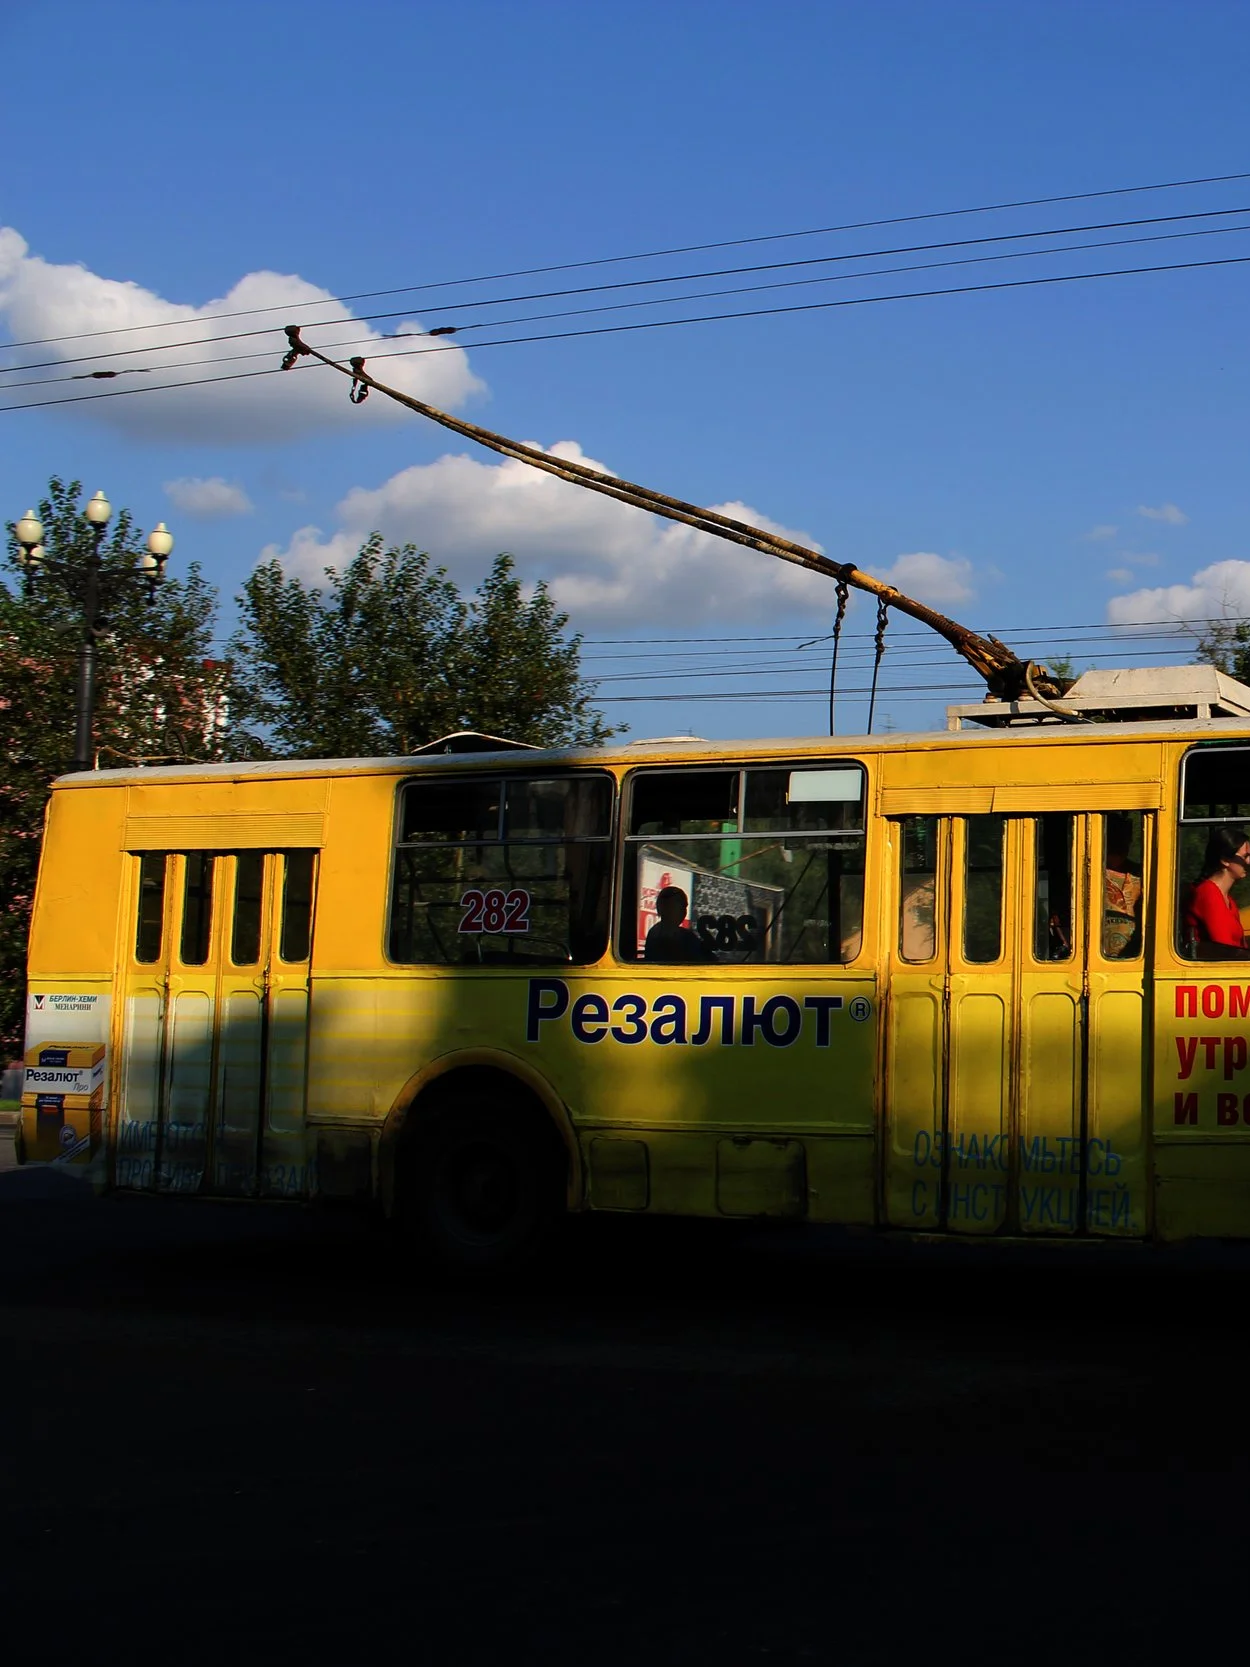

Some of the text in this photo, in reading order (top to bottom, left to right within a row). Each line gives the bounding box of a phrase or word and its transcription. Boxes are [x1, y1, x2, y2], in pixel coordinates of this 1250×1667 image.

[458, 889, 529, 933] 282
[73, 1082, 89, 1092] Про
[1174, 1092, 1198, 1126] и
[912, 1179, 927, 1217] С
